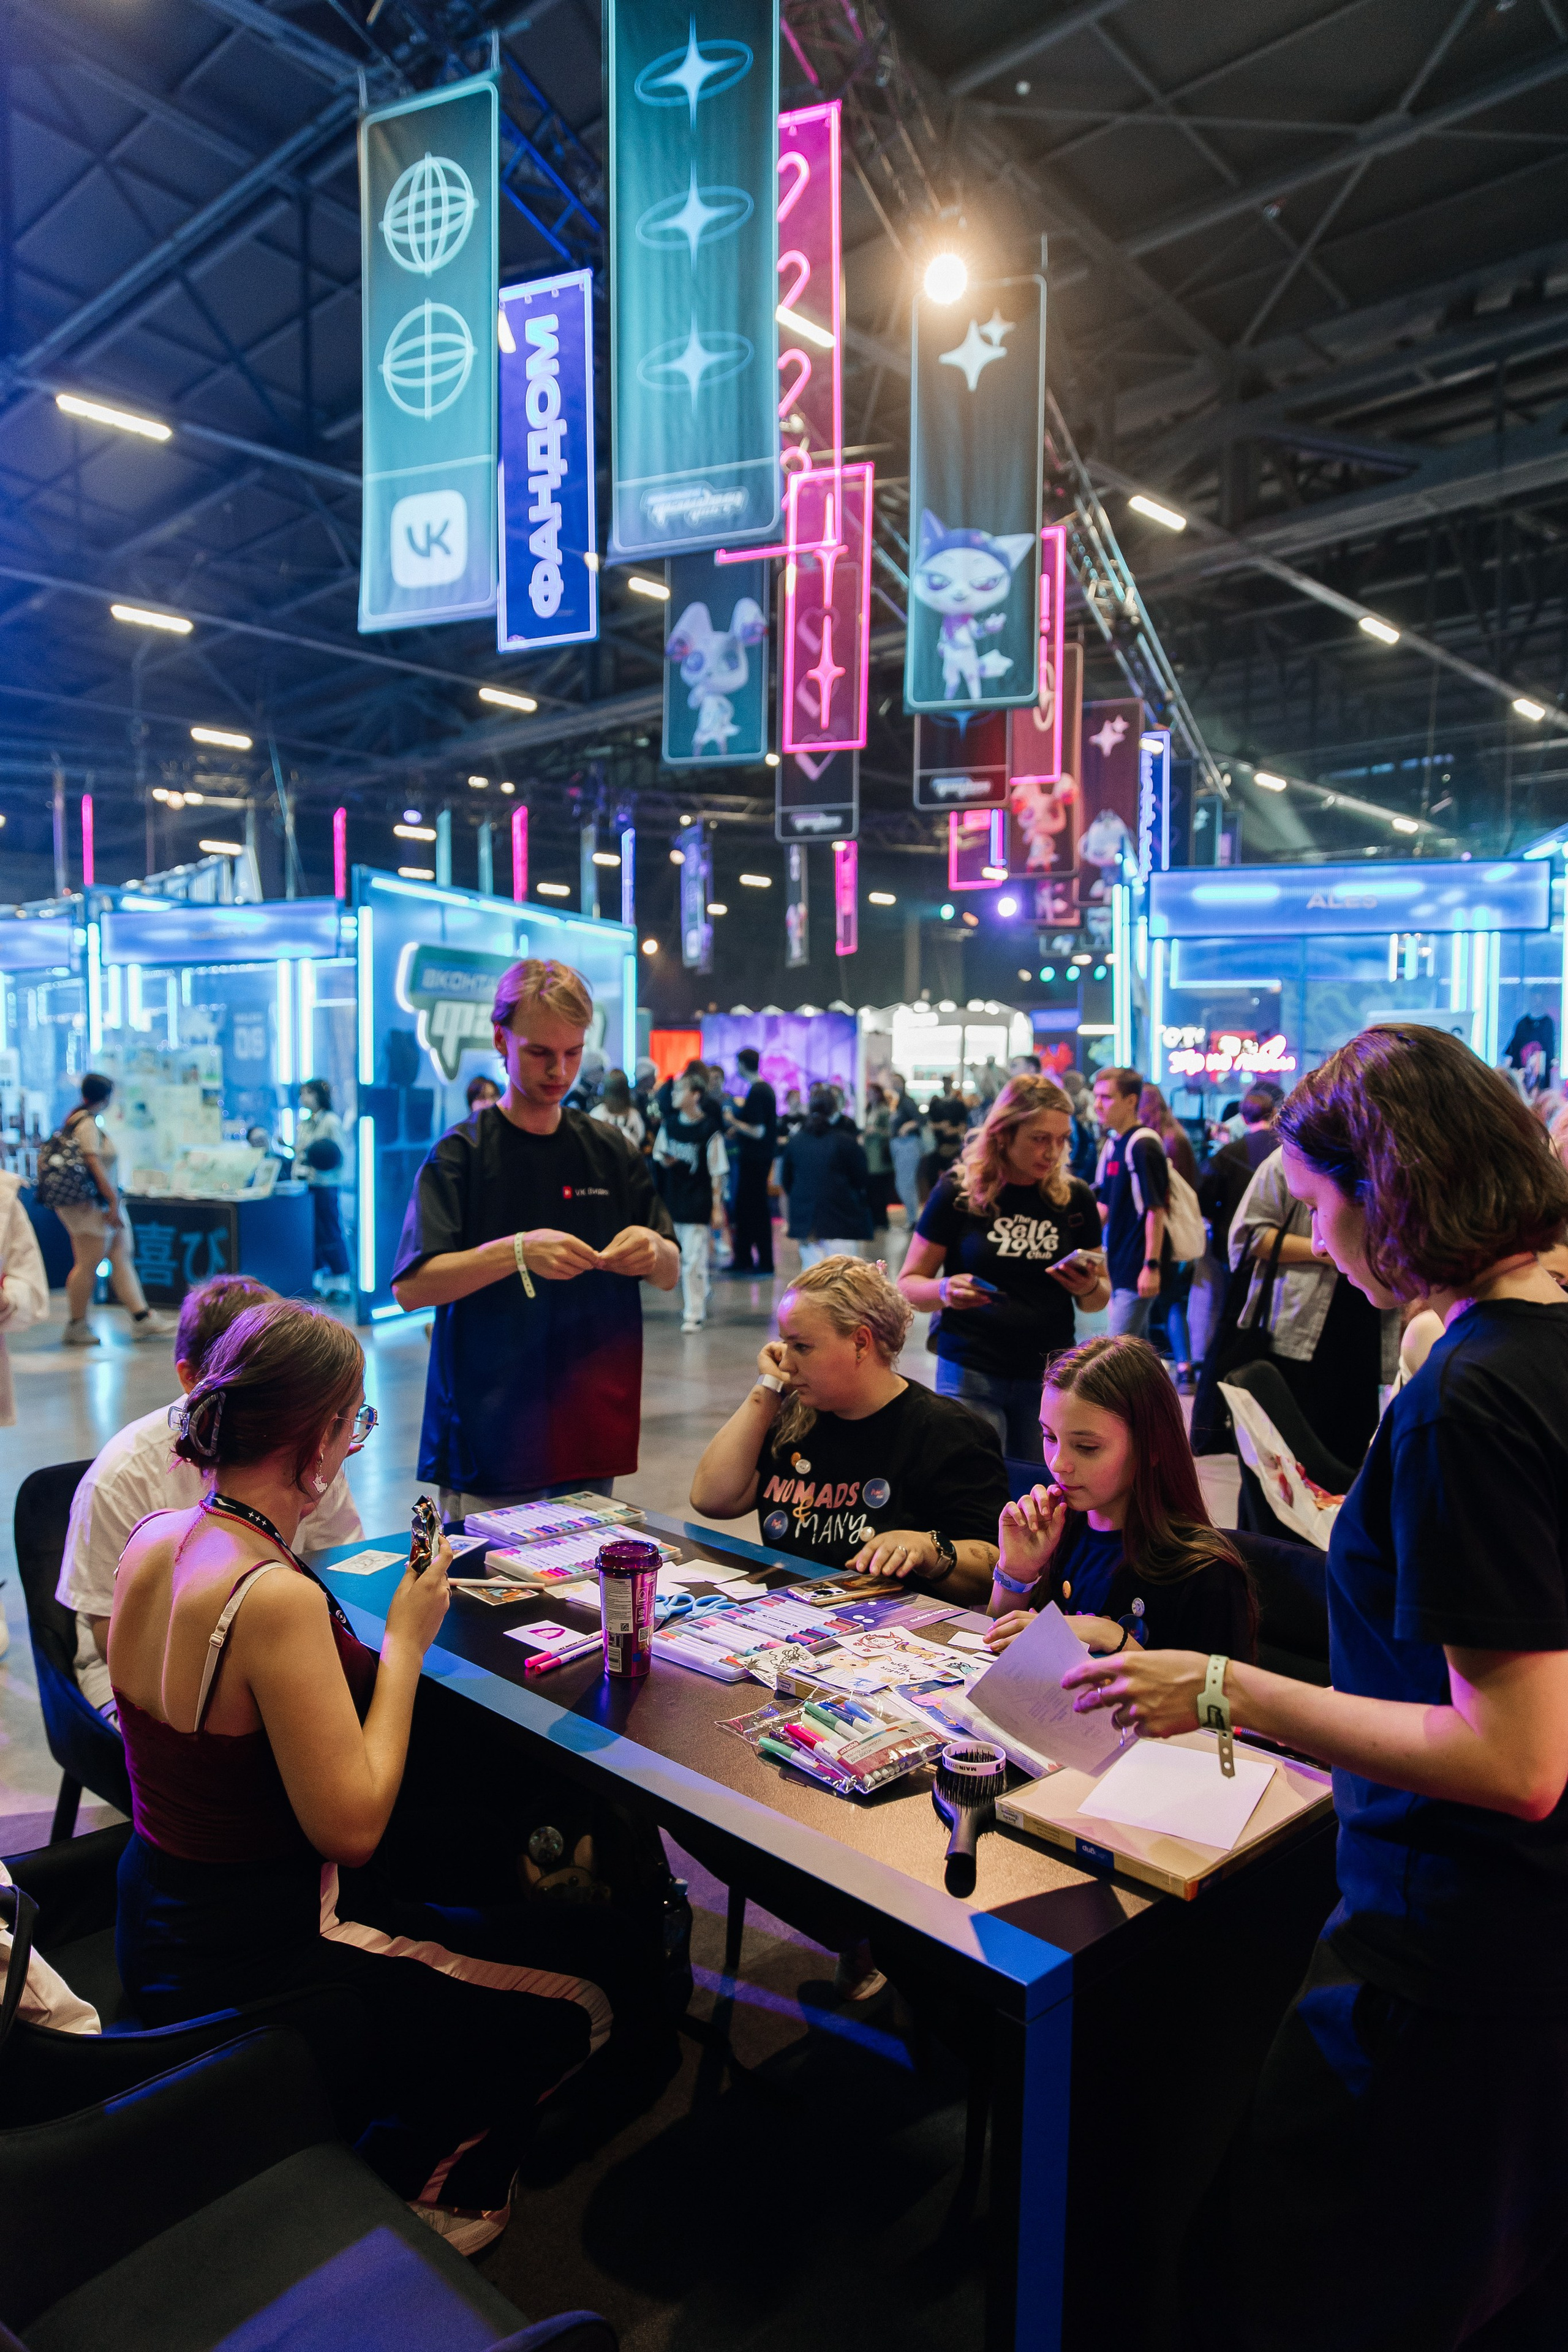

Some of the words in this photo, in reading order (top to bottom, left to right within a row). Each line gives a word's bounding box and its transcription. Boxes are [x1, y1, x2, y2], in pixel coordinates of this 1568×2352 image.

[525, 314, 567, 618] ФАНДОМ
[405, 518, 452, 558] VK
[1013, 1214, 1031, 1224] The
[997, 1234, 1060, 1257] Love
[1026, 1250, 1053, 1260] Club
[763, 1475, 860, 1509] NOMADS
[795, 1512, 867, 1545] MANY
